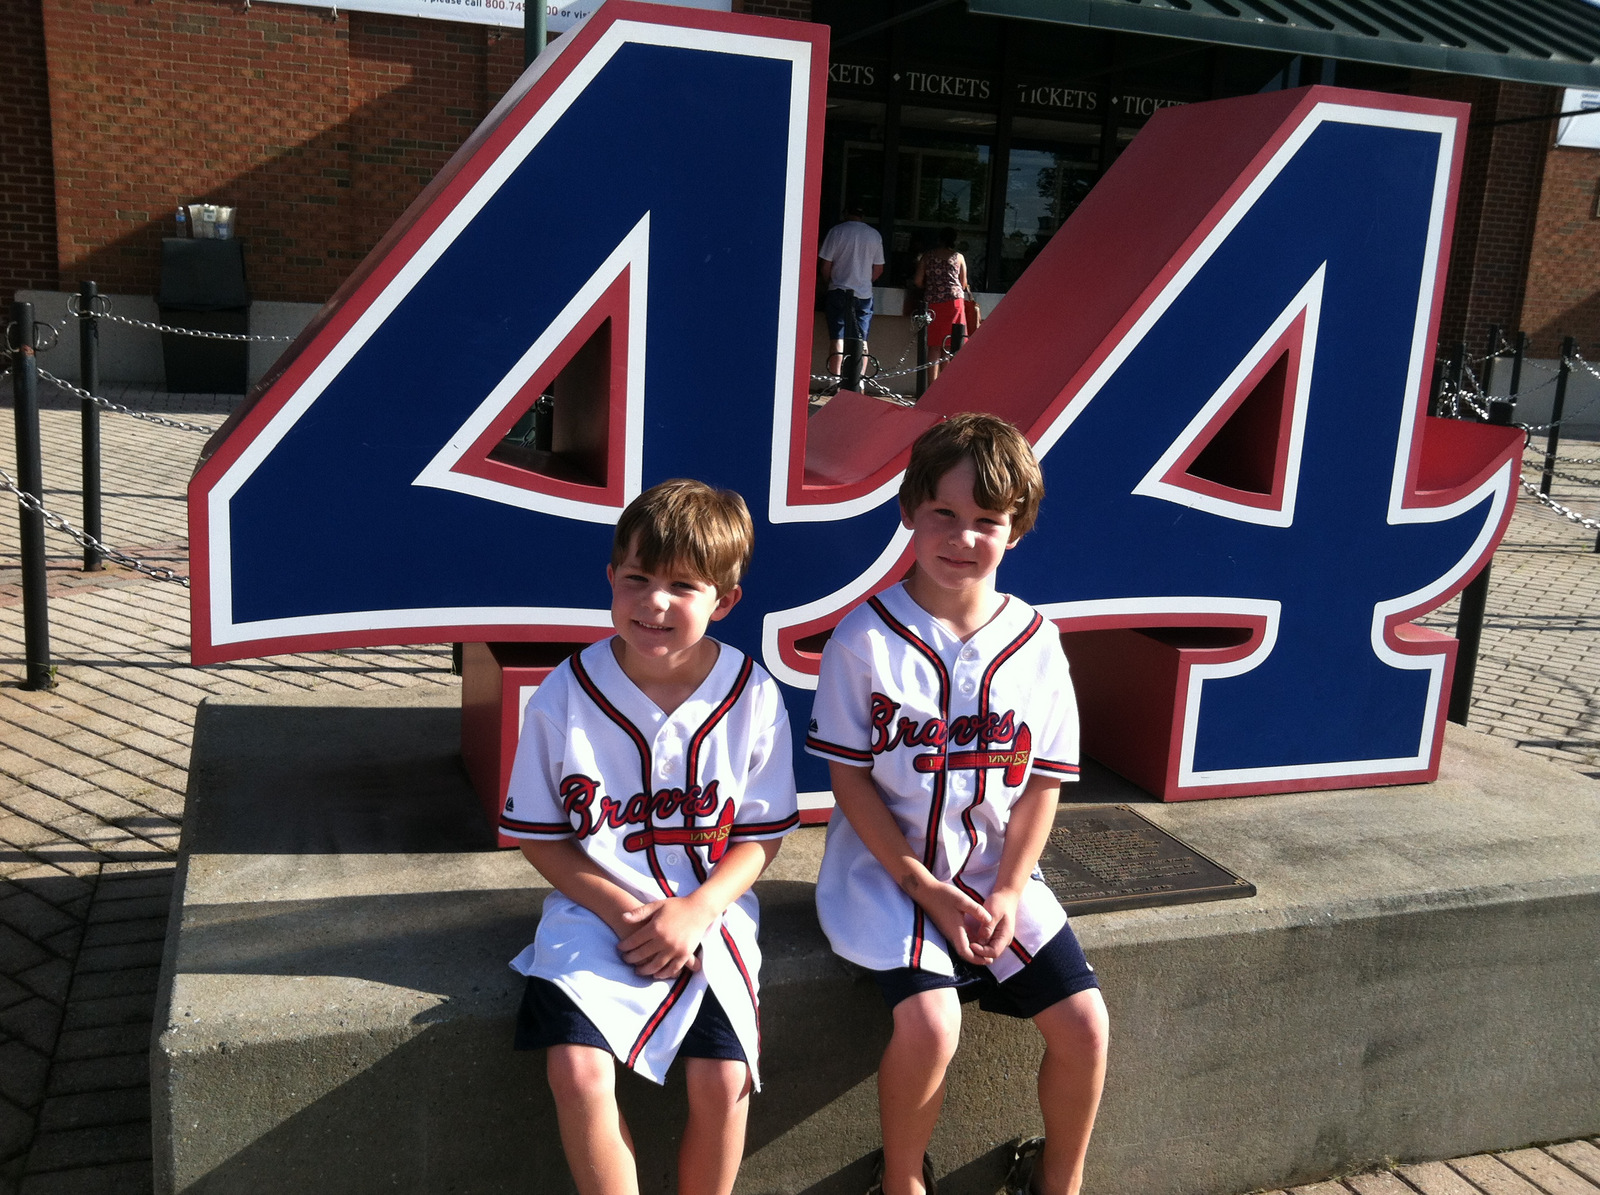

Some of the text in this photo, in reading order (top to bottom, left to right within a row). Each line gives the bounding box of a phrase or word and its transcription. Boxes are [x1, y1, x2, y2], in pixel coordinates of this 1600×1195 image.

[906, 71, 990, 99] TICKETS
[1017, 84, 1097, 111] TICKETS
[1122, 95, 1189, 116] TICK
[871, 692, 1015, 755] Braves
[559, 774, 719, 840] Braves
